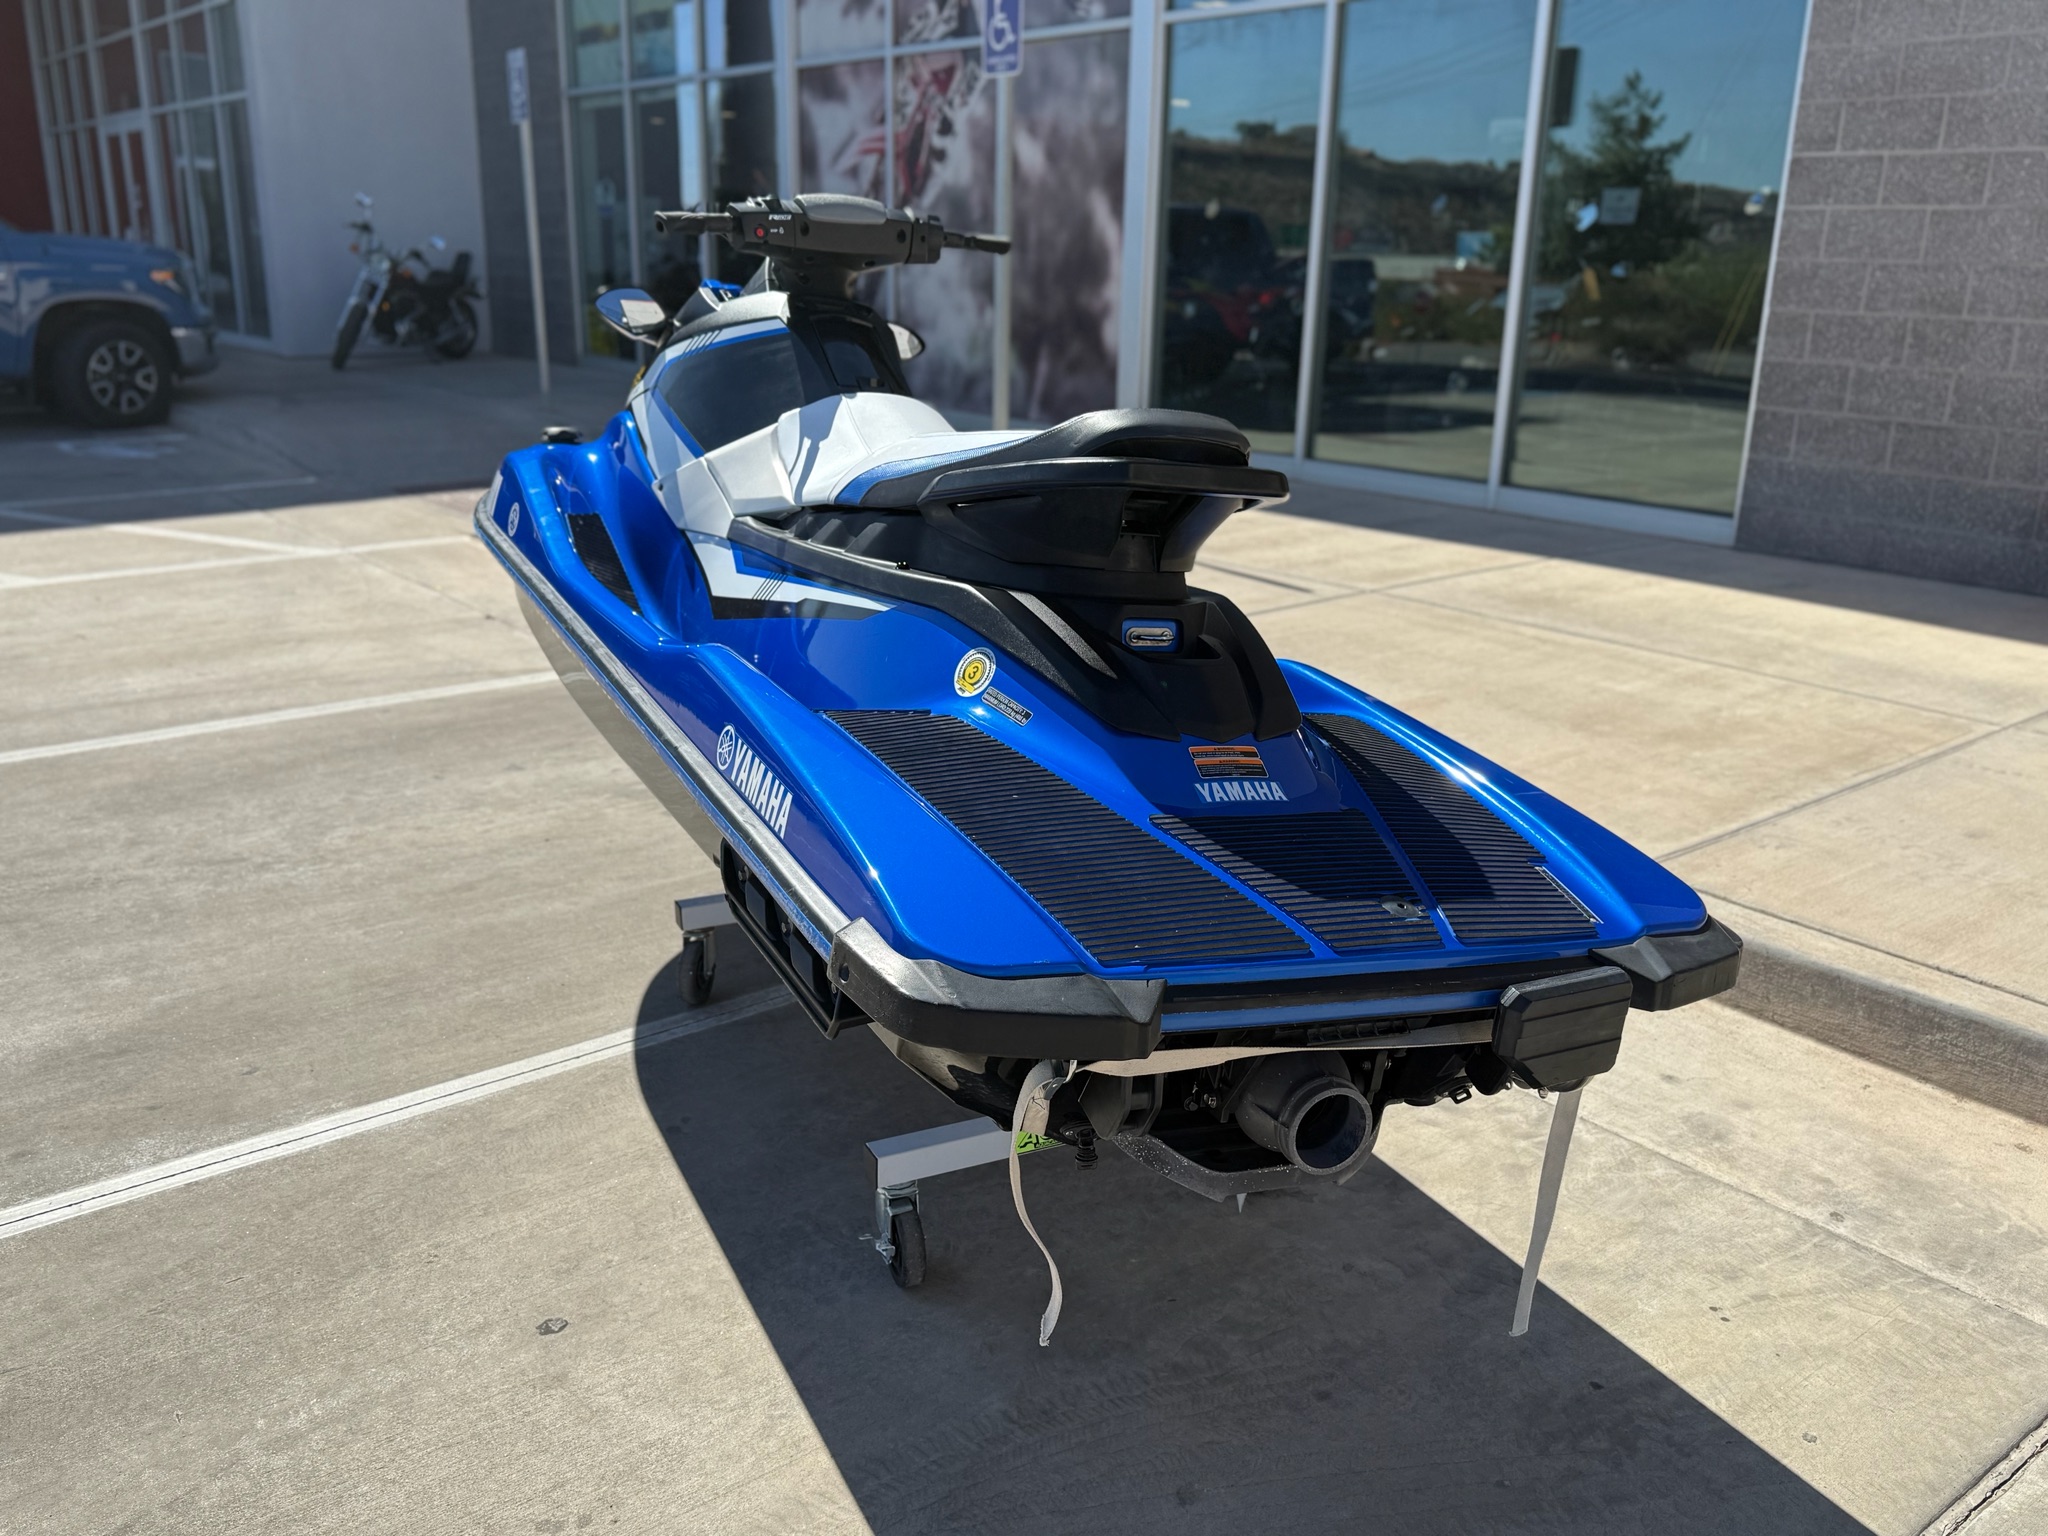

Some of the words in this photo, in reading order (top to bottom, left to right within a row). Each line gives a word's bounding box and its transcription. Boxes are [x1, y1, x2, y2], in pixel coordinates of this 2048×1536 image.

[968, 665, 979, 680] 3
[731, 738, 793, 840] YAMAHA
[1194, 781, 1289, 802] YAMAHA
